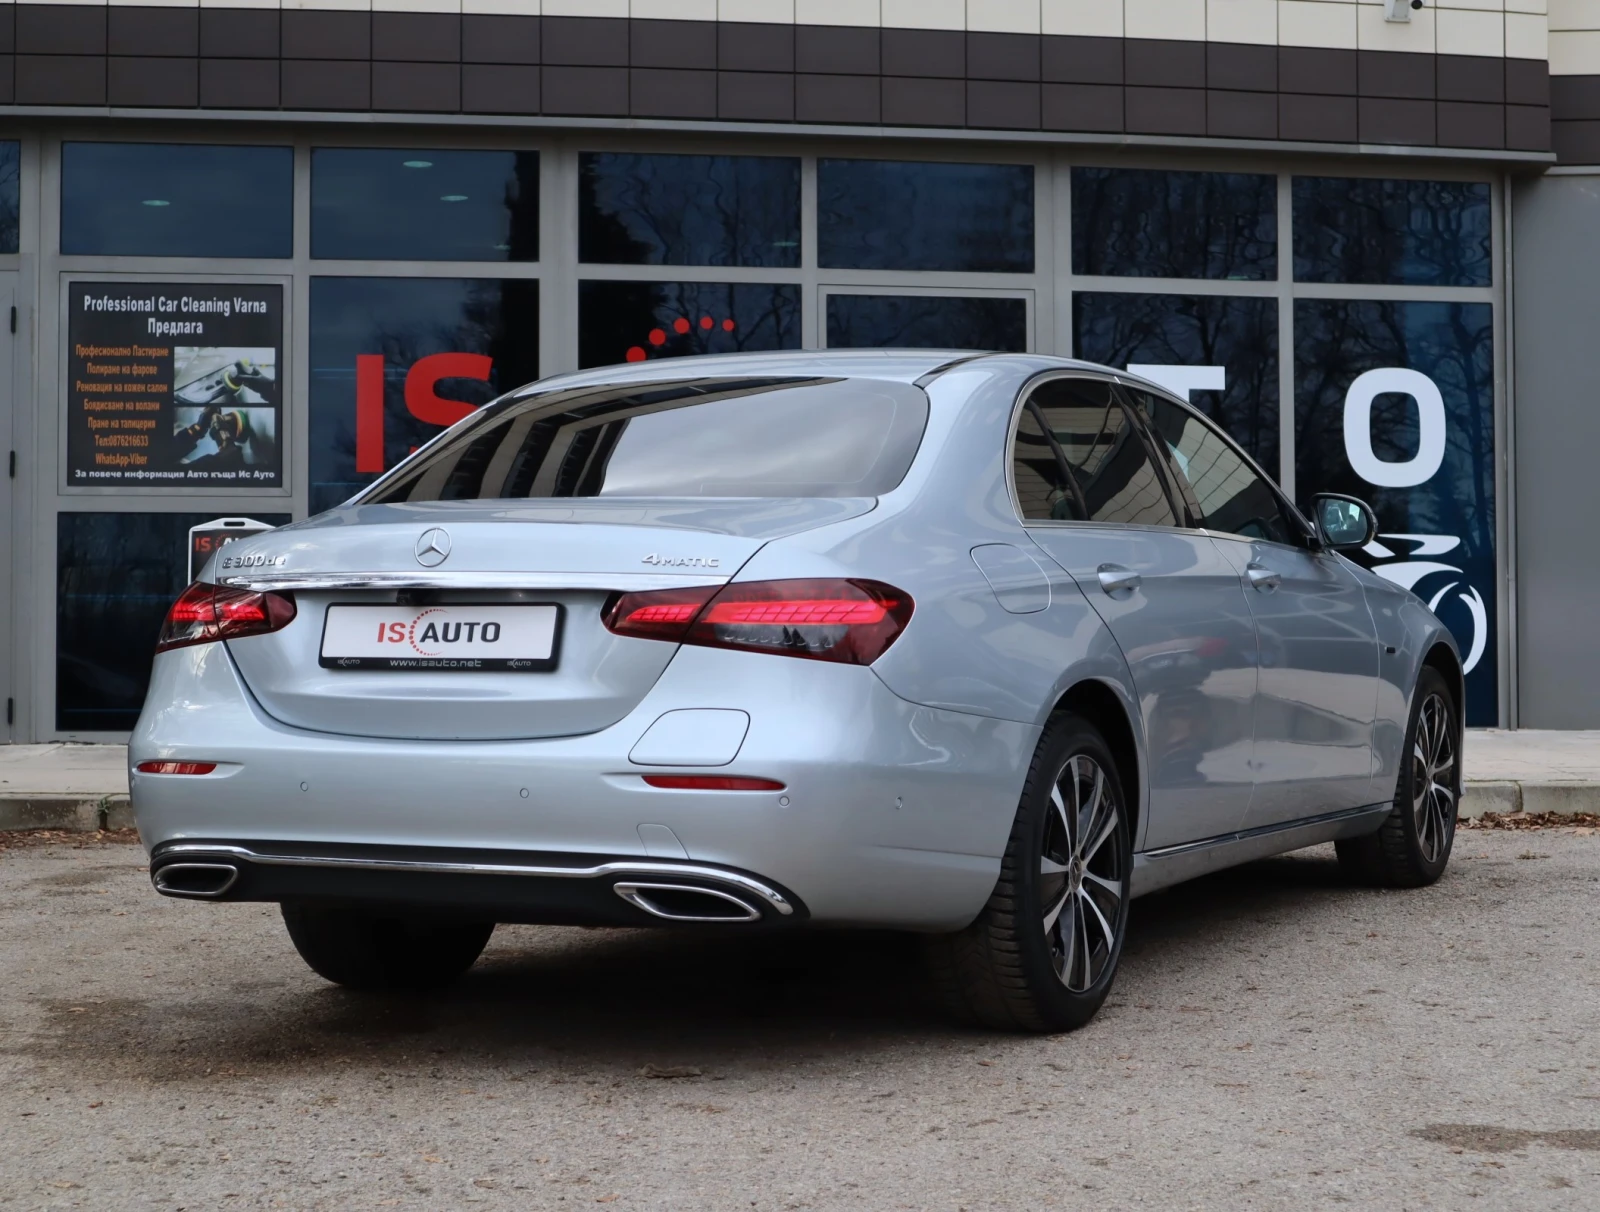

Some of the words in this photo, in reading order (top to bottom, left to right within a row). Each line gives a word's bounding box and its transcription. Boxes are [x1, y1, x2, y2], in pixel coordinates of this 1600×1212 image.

[84, 295, 154, 312] Professional
[158, 297, 178, 312] Car
[181, 297, 230, 317] Cleaning
[233, 297, 267, 313] Varna
[148, 318, 203, 337] Предлага
[76, 344, 131, 359] Професионално
[132, 345, 169, 359] Пастиране
[87, 362, 120, 377] Полиране
[122, 366, 130, 374] на
[131, 363, 157, 378] фарове
[76, 381, 113, 394] Реновация
[114, 384, 123, 392] на
[124, 384, 146, 393] кожен
[147, 384, 168, 393] салон
[84, 398, 124, 412] Боядисване
[125, 402, 134, 410] на
[135, 402, 160, 411] волани
[356, 352, 493, 473] IS
[88, 416, 109, 431] Пране
[110, 420, 119, 429] на
[120, 420, 156, 431] тапицерия
[95, 453, 148, 467] WhatsApp-Viber
[75, 470, 87, 478] За
[89, 470, 122, 478] повече
[124, 470, 185, 480] информация
[187, 470, 209, 479] Авто
[210, 471, 236, 480] къща
[238, 471, 251, 479] Ис
[253, 472, 275, 480] Ауто
[195, 537, 212, 552] IS
[641, 552, 720, 568] 4MATIC
[419, 621, 501, 643] AUTO
[390, 657, 482, 668] www.isauto.net
